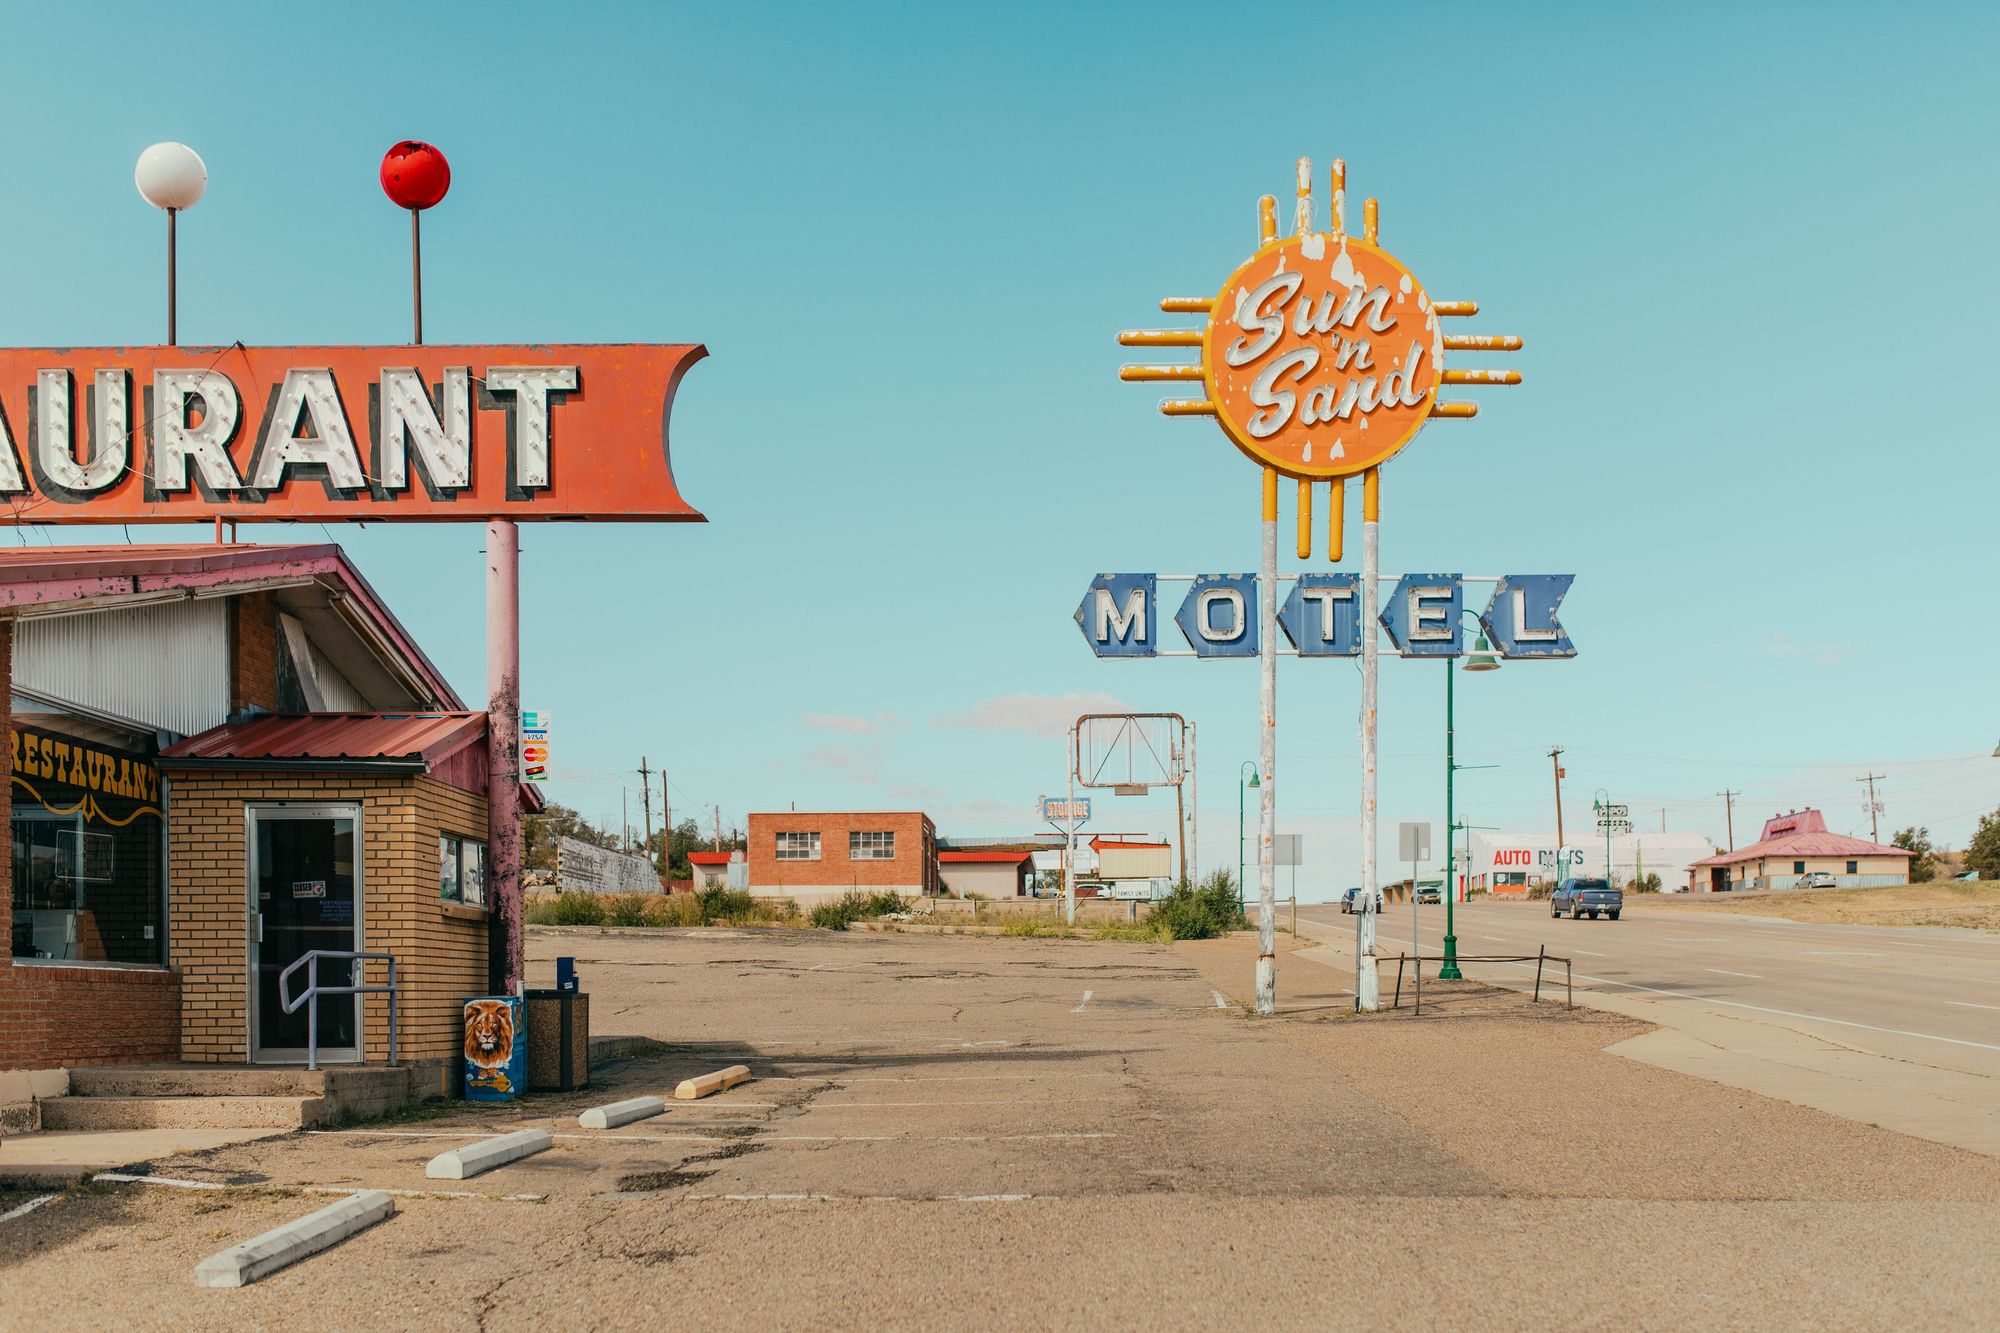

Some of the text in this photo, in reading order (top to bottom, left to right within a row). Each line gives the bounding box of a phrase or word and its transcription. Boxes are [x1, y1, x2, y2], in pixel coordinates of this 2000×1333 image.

[1225, 271, 1397, 367] Sun
[0, 366, 581, 493] URANT
[1247, 339, 1426, 438] Sand
[1095, 585, 1559, 643] MOTEL
[10, 730, 161, 803] RESTAURANT
[1494, 850, 1584, 865] AUTO PTS
